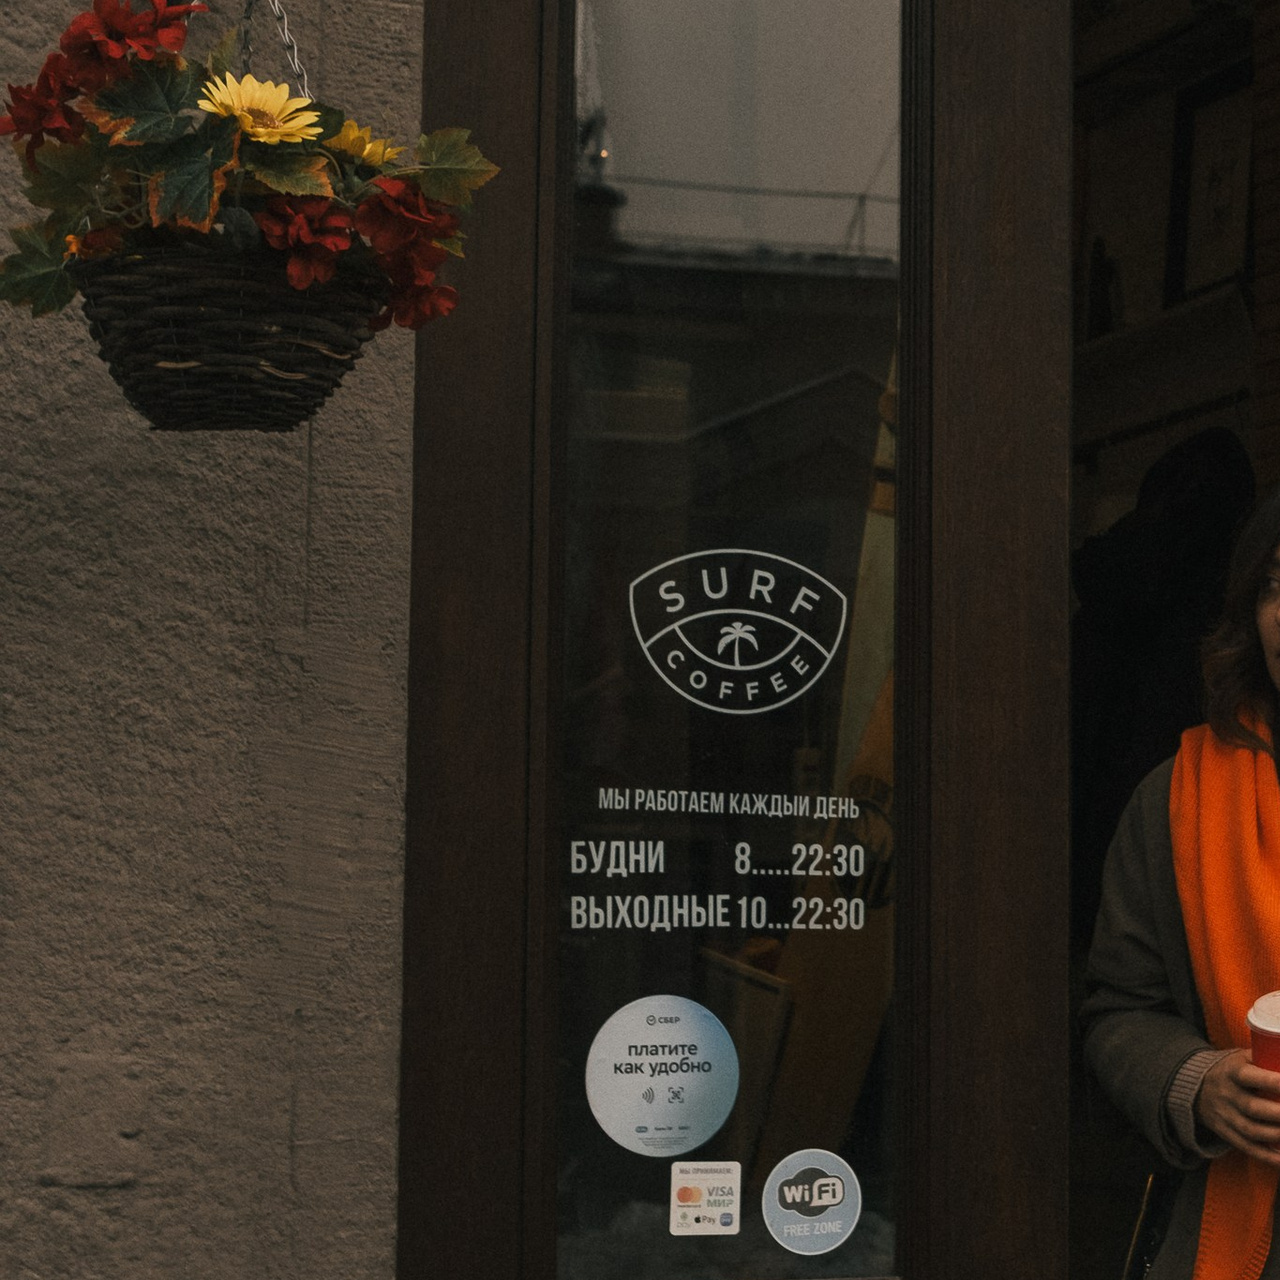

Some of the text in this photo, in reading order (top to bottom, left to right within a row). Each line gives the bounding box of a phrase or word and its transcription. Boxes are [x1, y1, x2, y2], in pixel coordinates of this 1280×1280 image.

[658, 567, 820, 615] SURF
[667, 650, 810, 701] COFFEE
[598, 787, 630, 810] МЫ
[634, 789, 725, 813] РАБОТАЕМ
[813, 797, 860, 819] ДЕНЬ
[570, 841, 665, 878] БУДНИ
[570, 895, 731, 933] ВЫХОДНЫЕ
[627, 1042, 698, 1057] платите
[613, 1056, 713, 1078] как удобно
[706, 1199, 734, 1208] МИР
[707, 1186, 734, 1197] VISA
[782, 1220, 843, 1237] FREE ZONE
